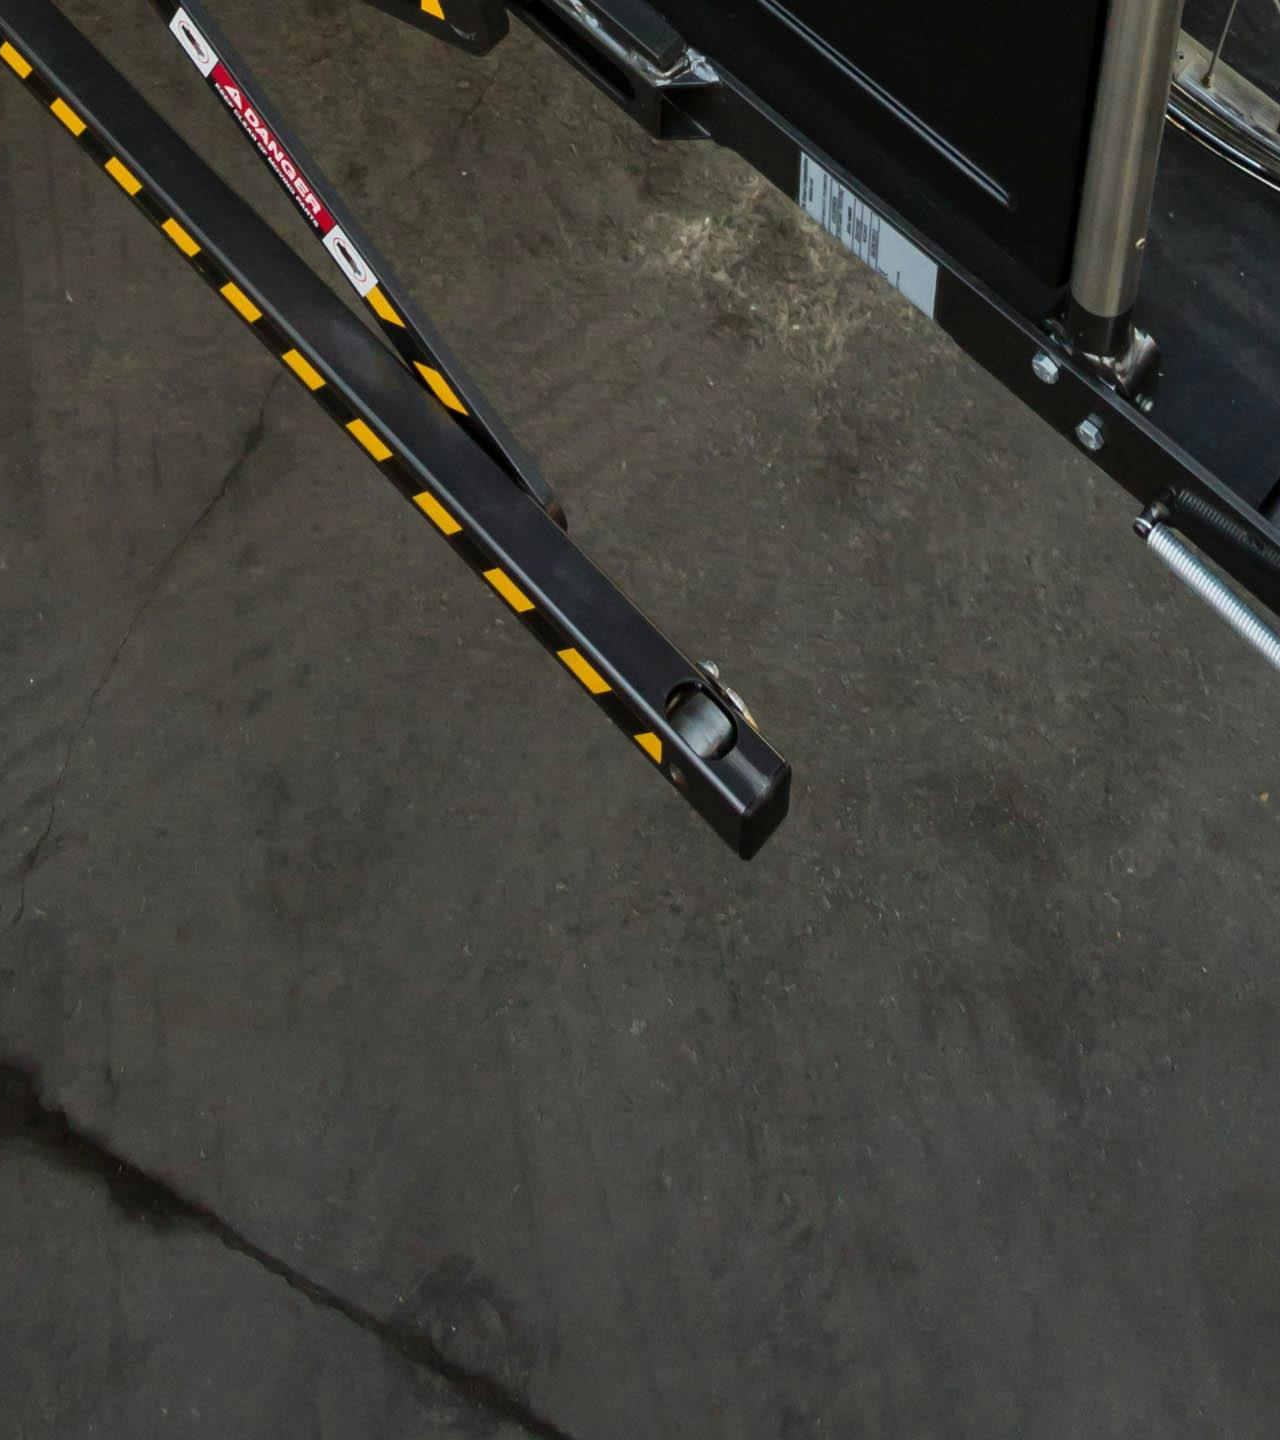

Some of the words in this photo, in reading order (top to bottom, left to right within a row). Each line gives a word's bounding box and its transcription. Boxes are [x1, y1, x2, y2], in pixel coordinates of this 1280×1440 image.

[215, 82, 234, 108] KEEP
[234, 109, 257, 141] CLEAR
[268, 157, 295, 194] MOVING
[296, 195, 319, 228] PARTS
[244, 108, 321, 214] DANGER
